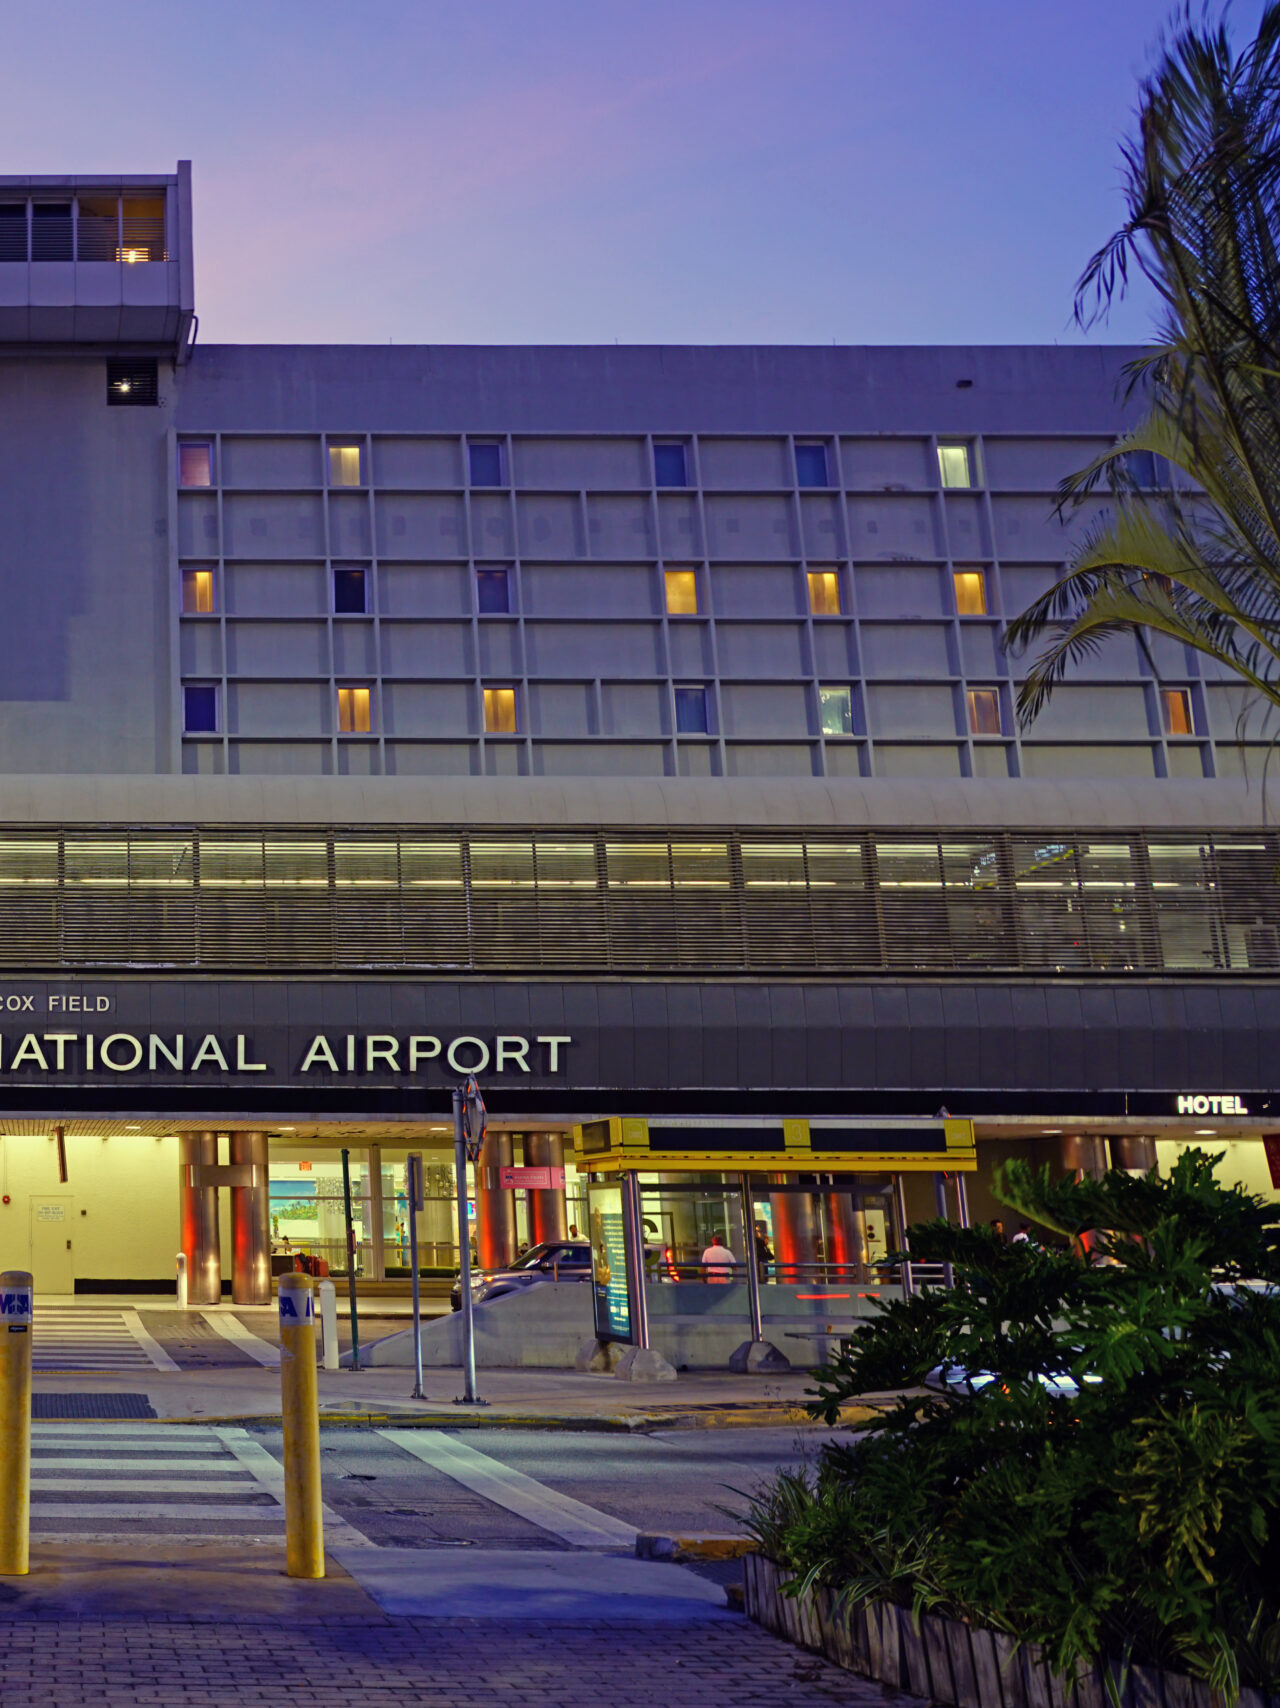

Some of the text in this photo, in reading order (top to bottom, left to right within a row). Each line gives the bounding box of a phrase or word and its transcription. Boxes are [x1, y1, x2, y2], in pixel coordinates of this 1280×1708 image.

[48, 995, 110, 1012] FIELD
[299, 1034, 573, 1074] AIRPORT
[1177, 1095, 1249, 1115] HOTEL
[791, 1123, 802, 1141] 3
